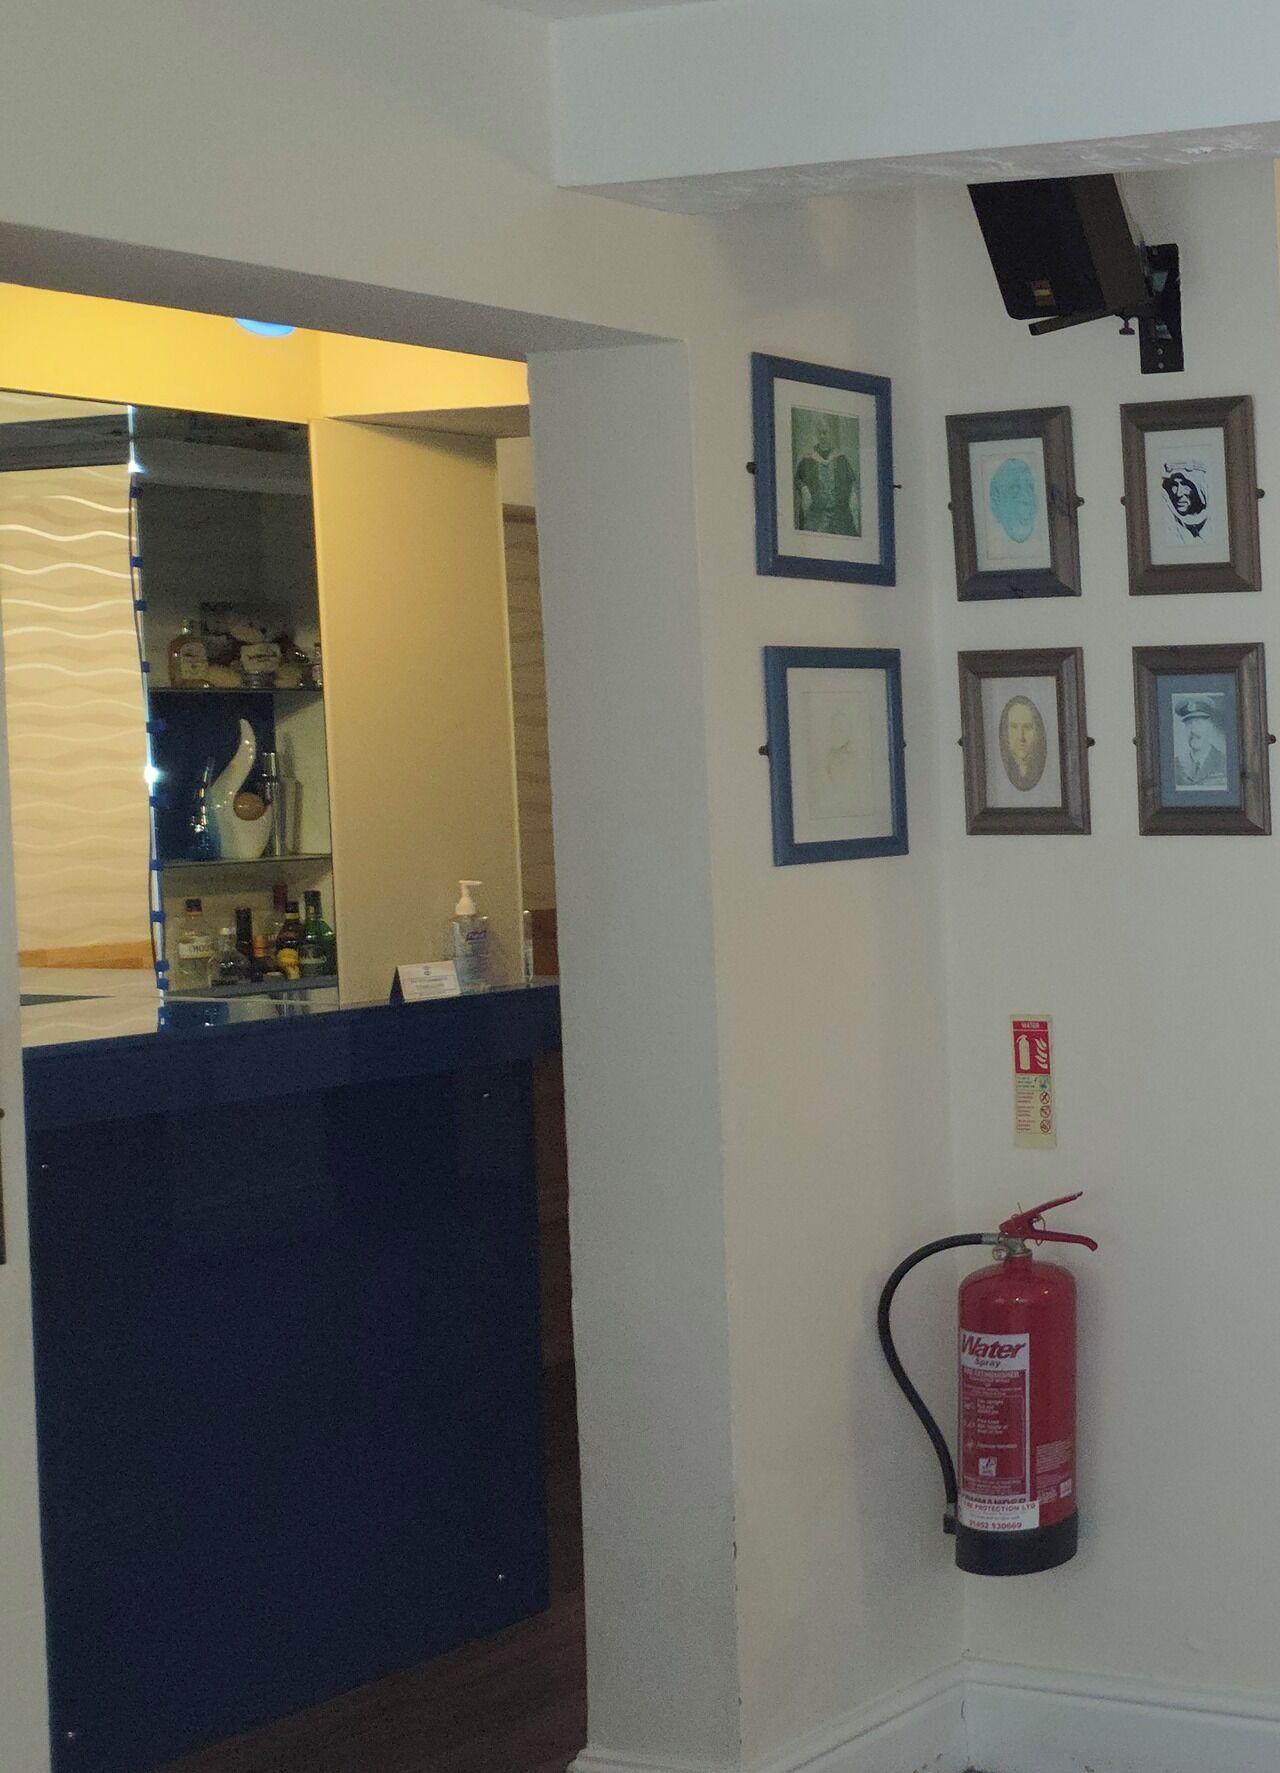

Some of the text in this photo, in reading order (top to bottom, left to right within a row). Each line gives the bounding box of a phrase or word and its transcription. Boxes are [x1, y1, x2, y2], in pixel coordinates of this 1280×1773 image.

[962, 1334, 1026, 1359] Water
[976, 1359, 1001, 1368] Spray
[975, 1503, 1019, 1512] PROTECTION
